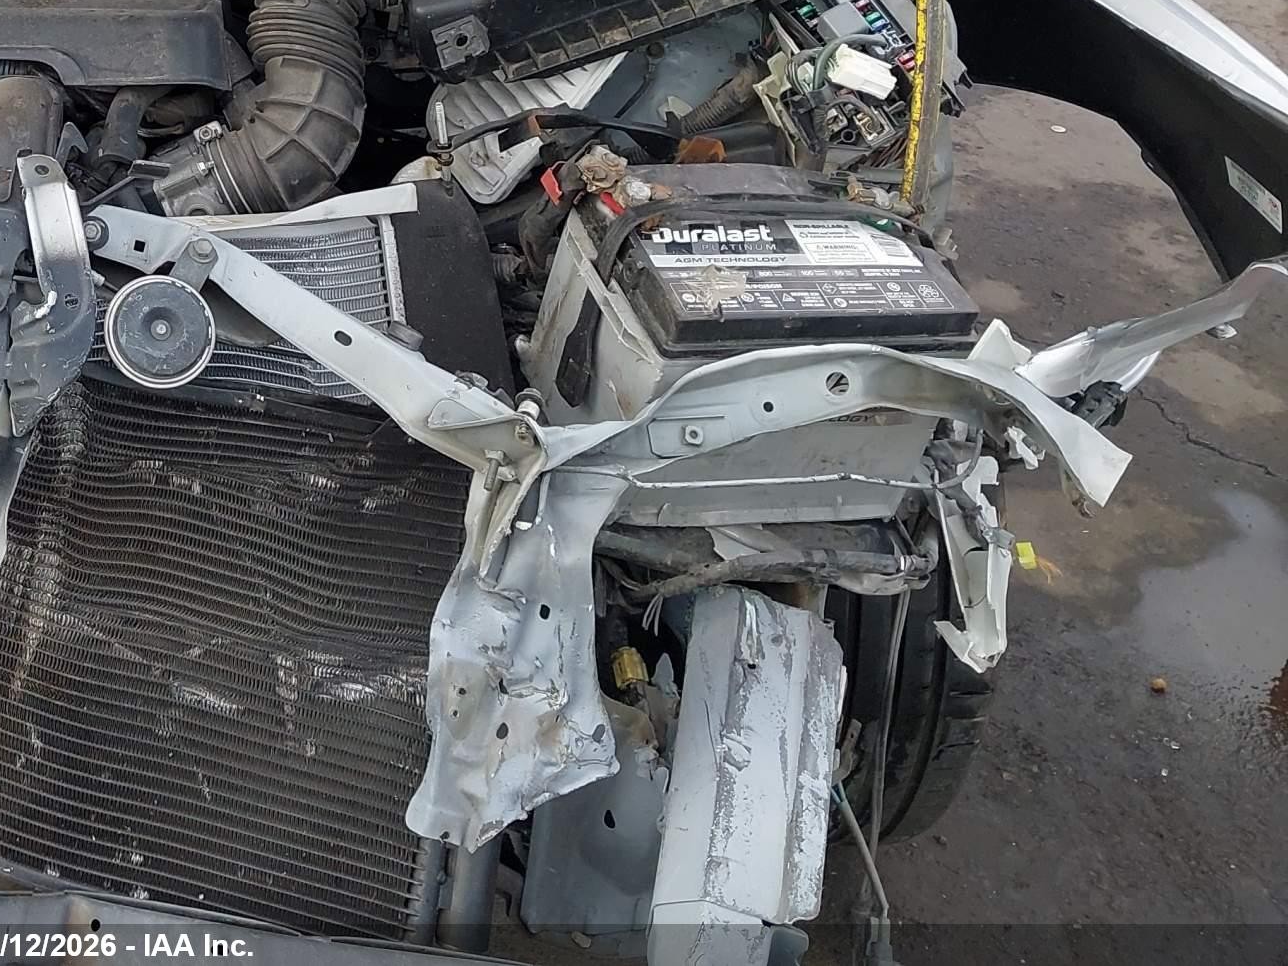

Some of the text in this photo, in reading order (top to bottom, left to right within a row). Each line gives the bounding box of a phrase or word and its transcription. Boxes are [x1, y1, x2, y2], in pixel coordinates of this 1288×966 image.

[651, 224, 775, 243] Duralast
[701, 243, 778, 252] PLATINUM
[674, 256, 788, 264] AGM TECHNOLOGY
